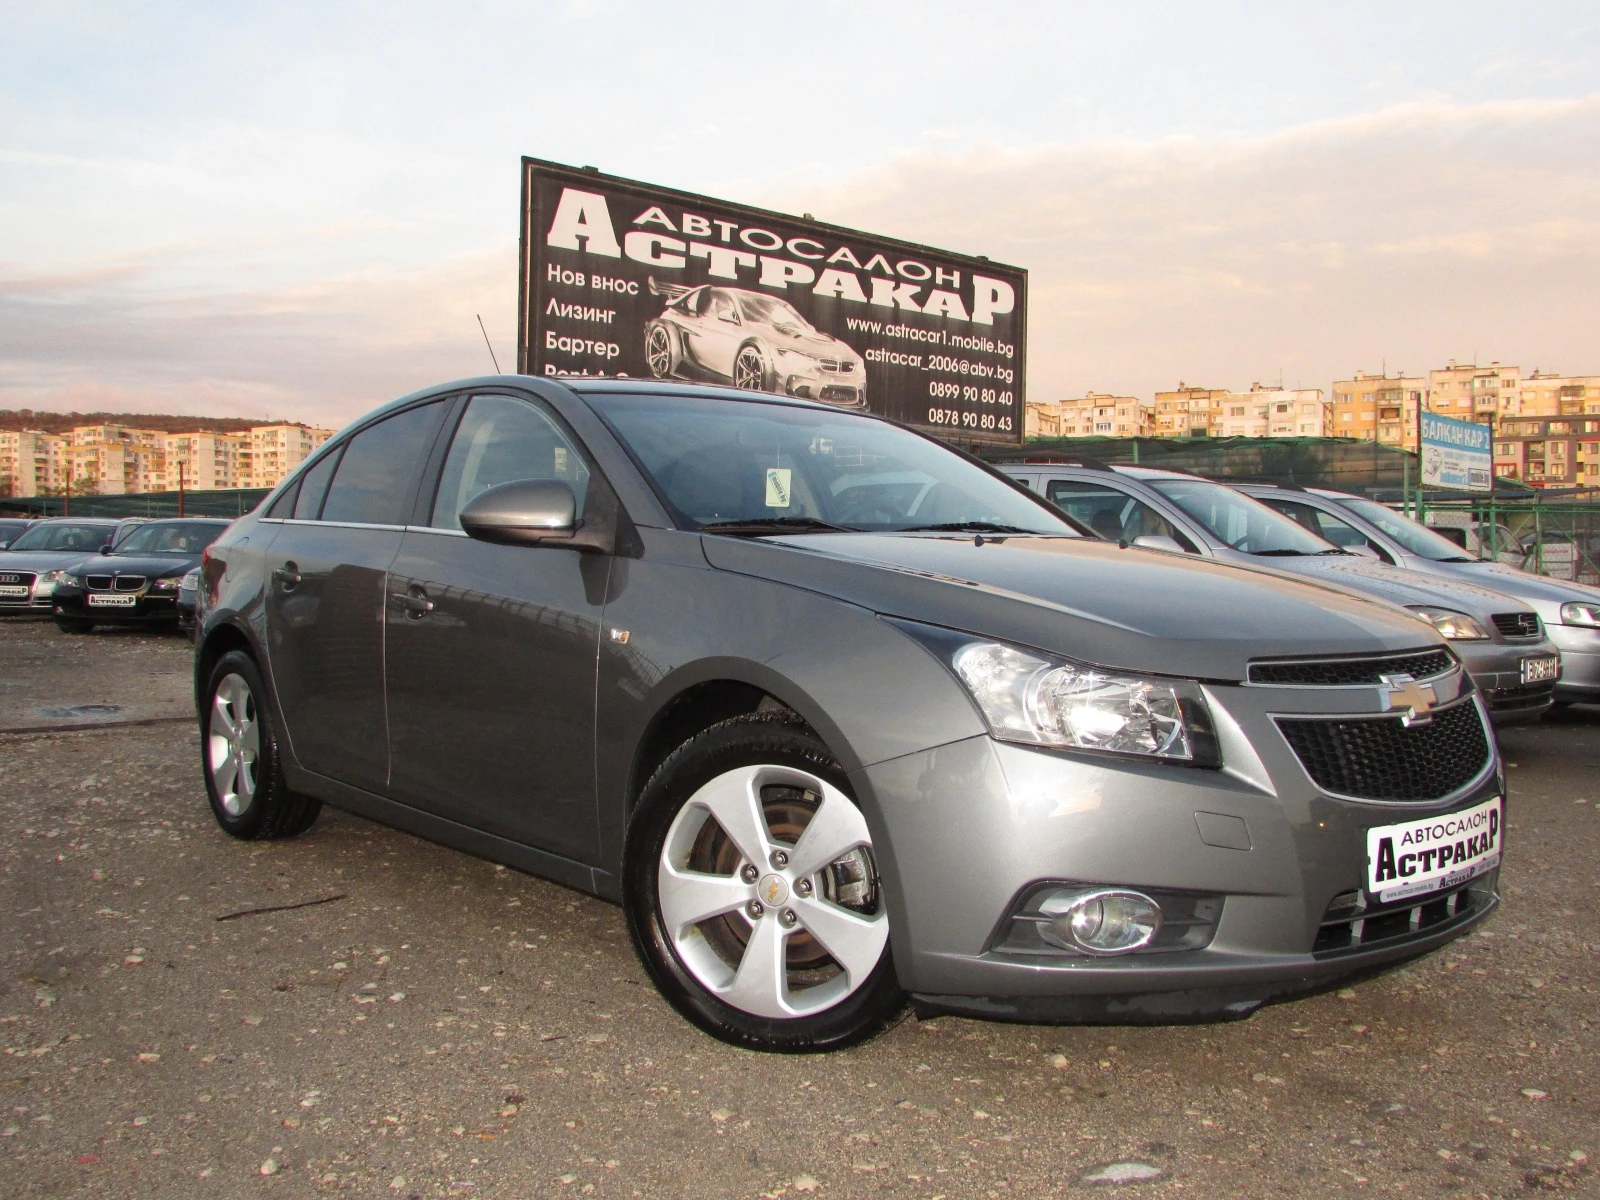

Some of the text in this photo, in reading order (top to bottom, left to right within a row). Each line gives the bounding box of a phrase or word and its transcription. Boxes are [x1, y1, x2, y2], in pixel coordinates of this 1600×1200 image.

[547, 187, 1015, 326] АСТРАКАР
[632, 206, 961, 288] АВТОСАЛОН
[547, 264, 639, 295] Нов внос
[546, 298, 616, 324] Лизинг
[546, 331, 620, 359] Бартер
[846, 318, 1014, 359] www.astracar1.mobile.bg
[865, 348, 1013, 383] astracar_2006@abv.bg
[929, 381, 1013, 406] 0899 90 80 40
[928, 408, 1012, 431] 0878 90 80 43
[1422, 419, 1463, 445] БАЛКАН
[1464, 428, 1483, 448] КАР
[1401, 810, 1487, 846] АВТОСАЛОН
[1375, 808, 1498, 883] АСТРАКАР
